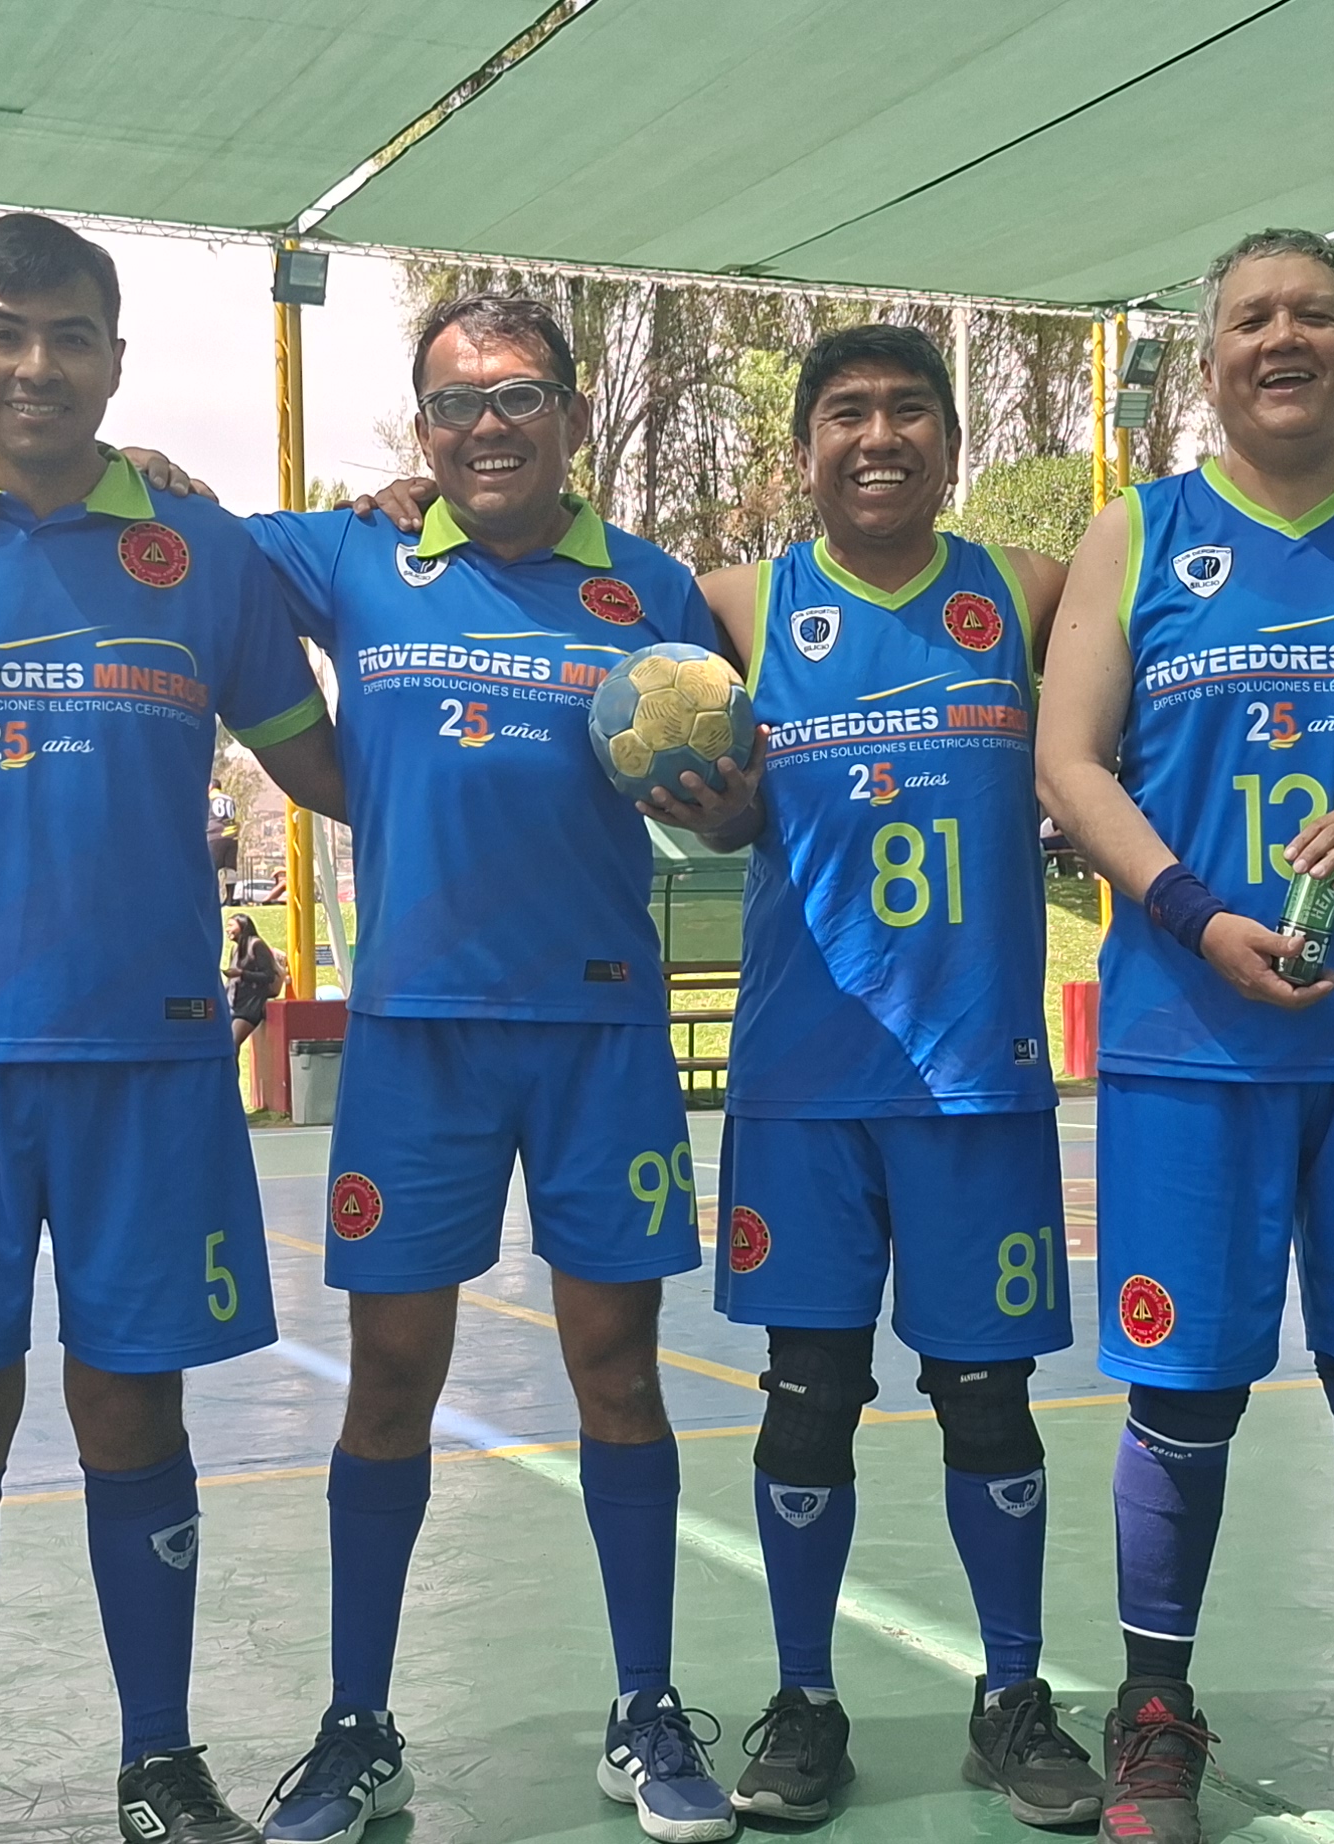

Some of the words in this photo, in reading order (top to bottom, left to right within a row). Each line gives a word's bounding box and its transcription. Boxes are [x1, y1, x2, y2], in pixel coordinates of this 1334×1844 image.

[358, 643, 551, 681] PROVEEDORES
[94, 663, 208, 707] MINEROS
[363, 676, 401, 695] EXPERTOS
[403, 675, 420, 688] EN
[423, 676, 508, 697] SOLUCIONES
[513, 687, 593, 710] ELÉCTRICAS
[1153, 688, 1202, 711] EXPERTOS
[1206, 684, 1224, 697] EN
[1227, 680, 1310, 694] SOLUCIONES
[49, 697, 132, 713] ELÉCTRICAS
[439, 698, 489, 738] 25
[501, 721, 552, 742] años
[1246, 702, 1296, 741] 25
[41, 735, 95, 753] años
[768, 706, 939, 750] ROVEEDORES
[812, 749, 828, 761] EN
[830, 742, 906, 758] SOLUCIONES
[909, 738, 980, 751] ELÉCTRICAS
[848, 762, 896, 800] 25
[905, 771, 950, 788] años
[870, 818, 963, 928] 81
[628, 1141, 698, 1236] 99
[205, 1230, 238, 1321] 5
[996, 1226, 1055, 1317] 81
